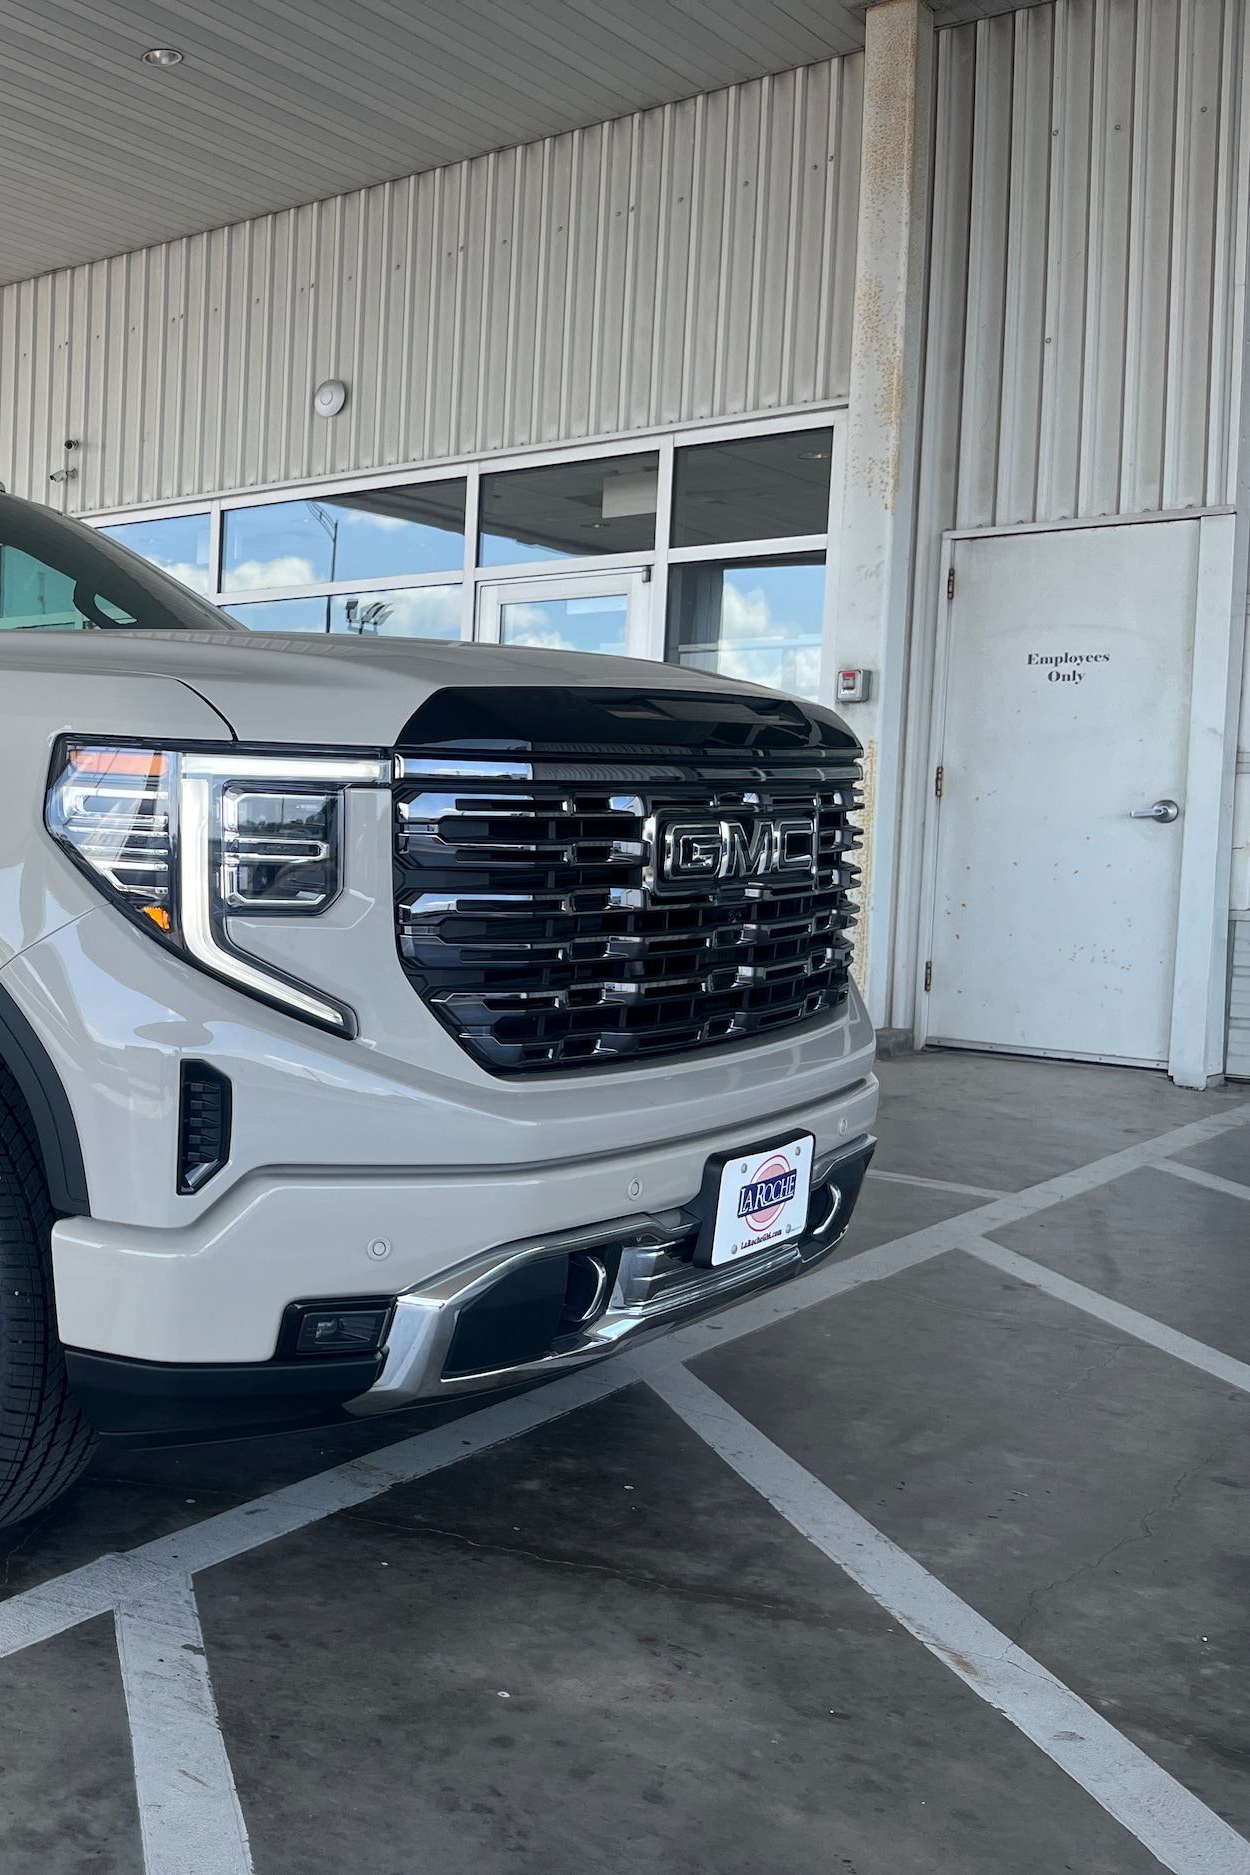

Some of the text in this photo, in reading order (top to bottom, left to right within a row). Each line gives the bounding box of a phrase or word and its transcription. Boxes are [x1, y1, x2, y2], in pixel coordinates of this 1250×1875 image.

[1027, 652, 1110, 667] Employees
[1047, 670, 1086, 685] Only
[664, 819, 814, 880] GMC
